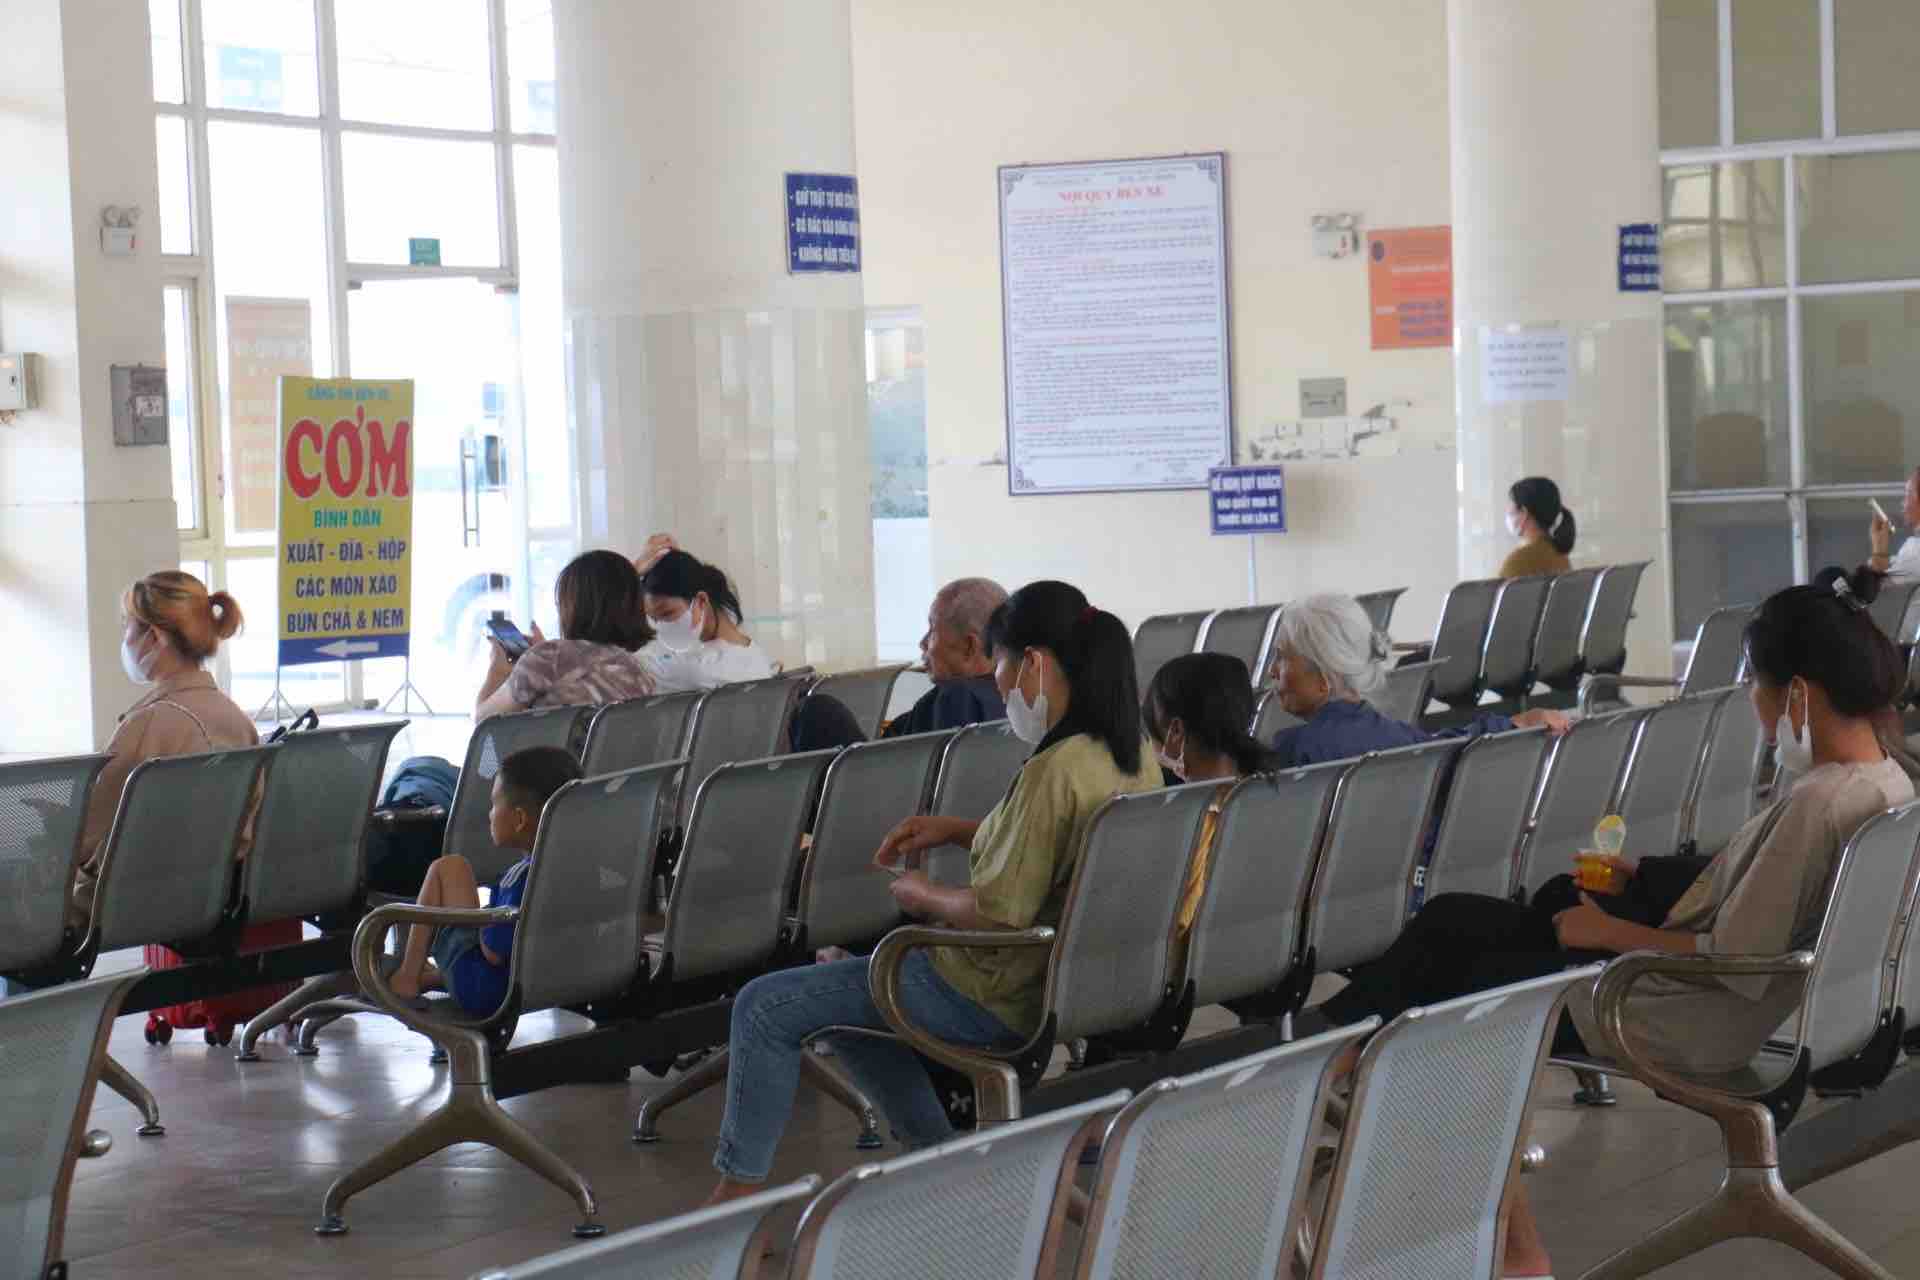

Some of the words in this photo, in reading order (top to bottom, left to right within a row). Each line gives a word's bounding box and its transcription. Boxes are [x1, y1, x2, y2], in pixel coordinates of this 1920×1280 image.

[286, 405, 410, 499] CƠM
[352, 507, 381, 528] DÂN
[287, 537, 324, 563] XUẤT
[339, 538, 364, 561] ĐĨA
[378, 537, 406, 562] HỘP
[296, 573, 325, 598] CÁC
[331, 573, 363, 597] MÓN
[287, 609, 317, 633] BÚN
[323, 604, 351, 631] CHẢ
[356, 610, 368, 629] &
[373, 608, 404, 628] NEM
